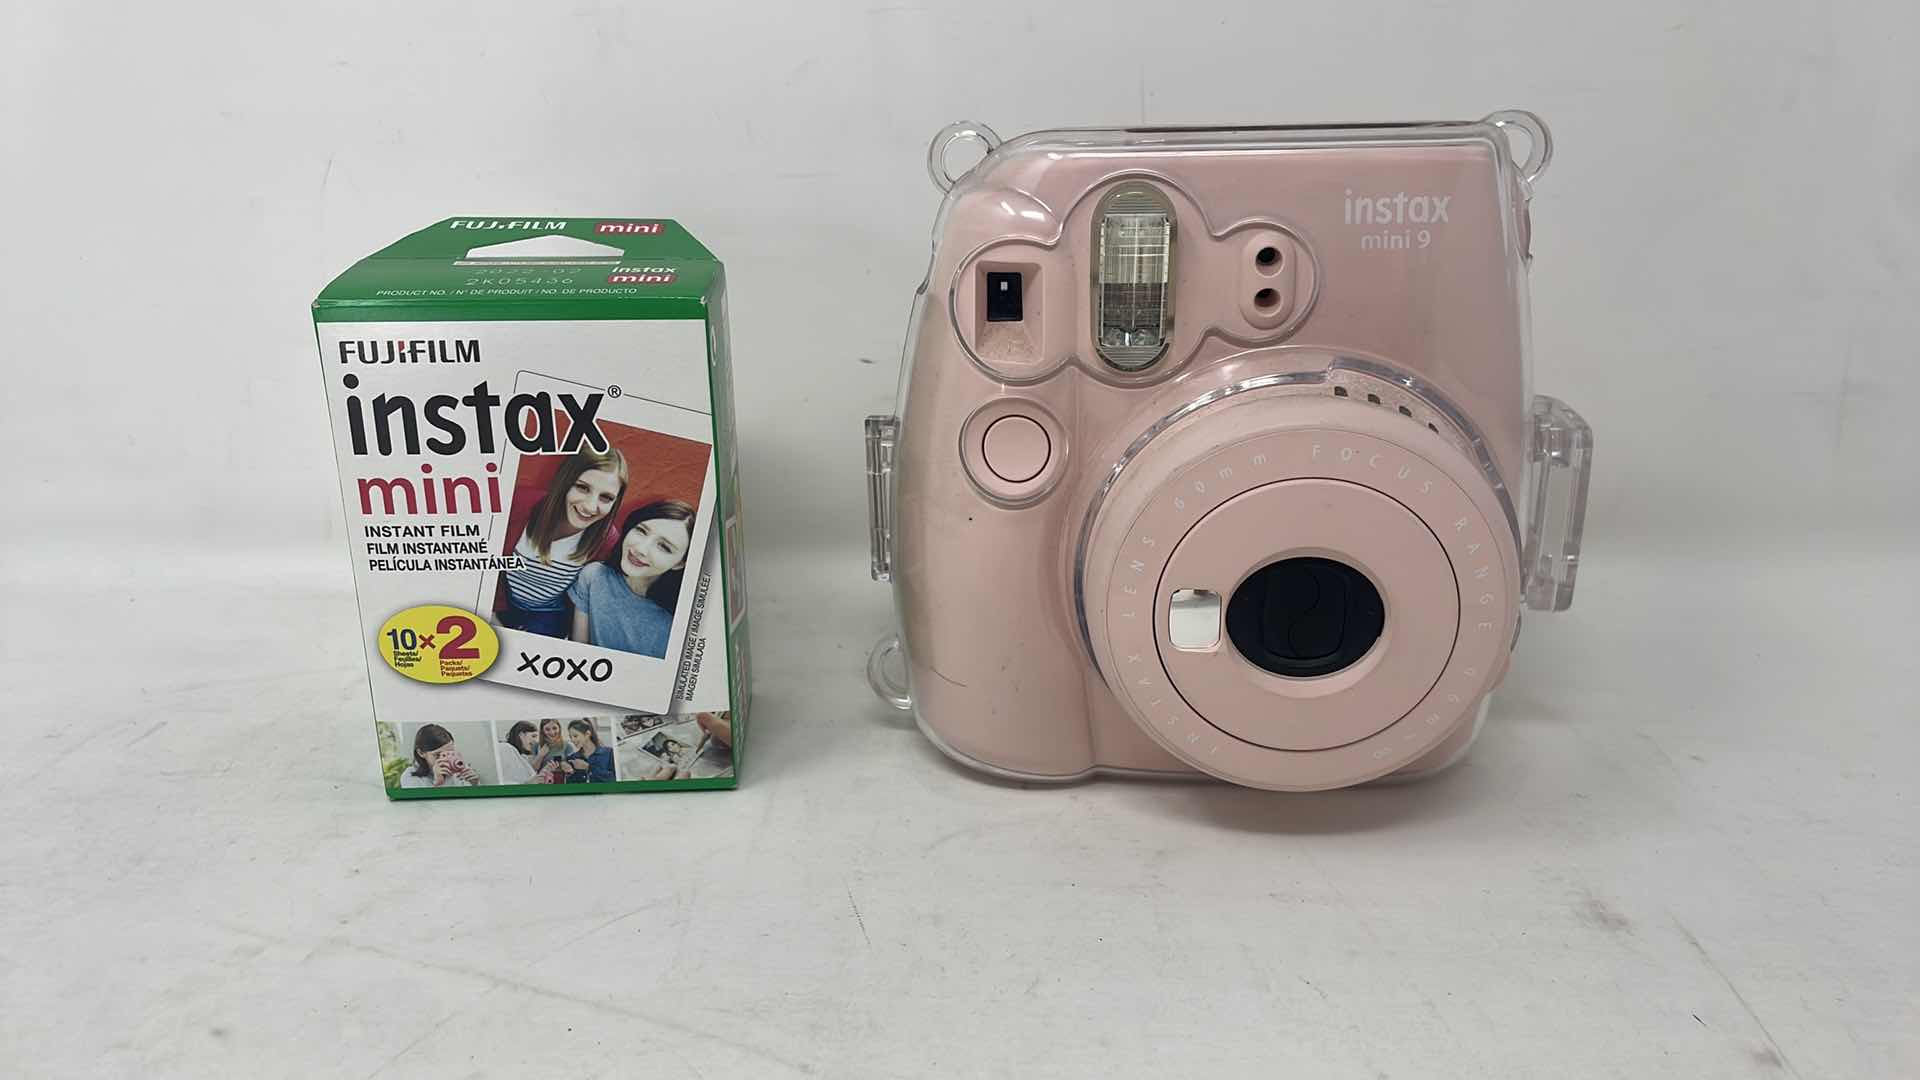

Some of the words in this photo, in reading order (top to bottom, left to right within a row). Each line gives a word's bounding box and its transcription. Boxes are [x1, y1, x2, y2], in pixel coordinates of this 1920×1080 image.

[1344, 187, 1451, 225] instax
[600, 223, 658, 233] mini
[1360, 229, 1410, 249] mini
[1417, 229, 1431, 249] 9
[613, 274, 672, 282] mini
[338, 339, 481, 364] FUJIFILM
[357, 463, 502, 514] mini
[364, 525, 435, 538] INSTANT
[440, 525, 480, 537] FILM
[1121, 535, 1155, 618] LENS
[1312, 444, 1433, 494] FOCUS
[1455, 517, 1495, 630] RANGE
[366, 542, 399, 555] FILM
[402, 537, 488, 554] INSTANTANÉ
[369, 556, 432, 571] PELÍCULA
[434, 555, 525, 571] INSTANTÁNEA
[685, 637, 697, 660] IMAGE
[692, 608, 702, 632] IMAGE
[691, 637, 706, 674] SIMULADA
[685, 673, 698, 701] IMAGEN
